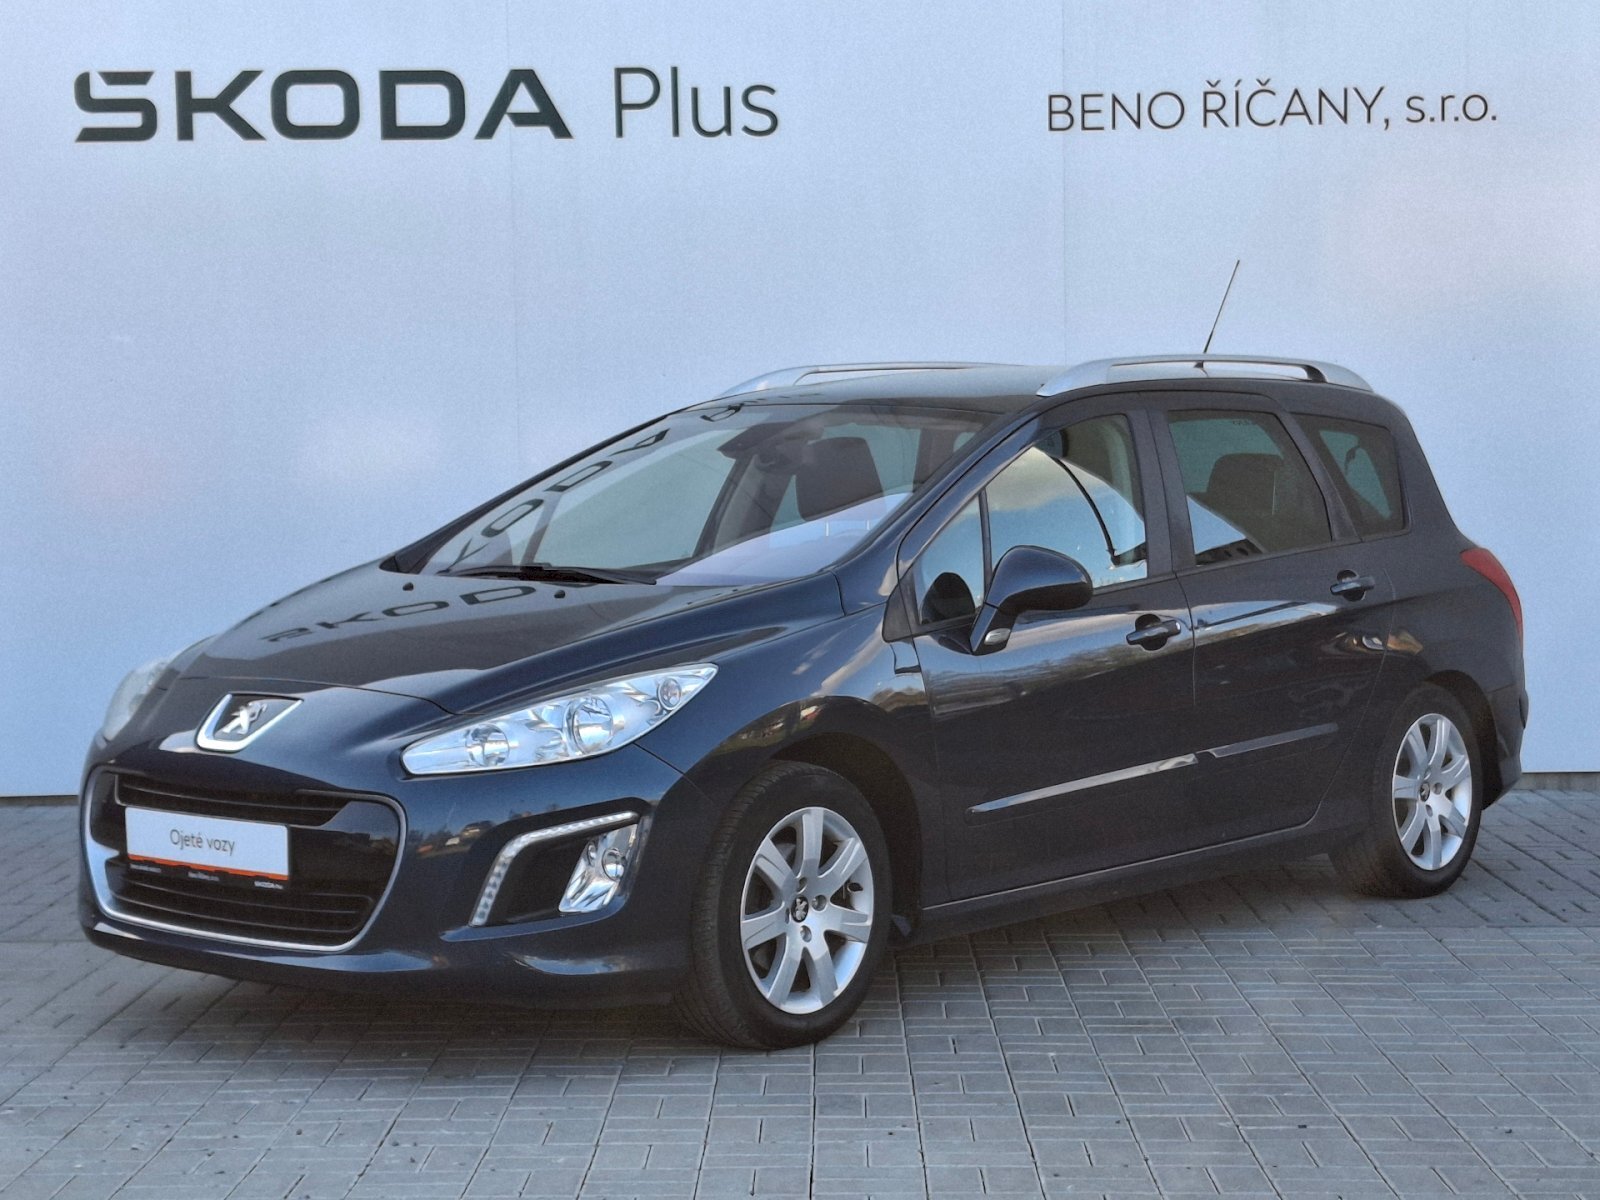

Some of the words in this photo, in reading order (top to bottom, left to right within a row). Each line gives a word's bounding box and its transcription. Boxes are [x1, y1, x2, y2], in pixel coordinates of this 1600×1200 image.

[615, 66, 778, 138] Plus
[1048, 92, 1185, 131] BENO
[1203, 78, 1390, 129] ŘÍČANY,
[1406, 94, 1497, 124] s.r.o.
[169, 829, 203, 850] Ojeté
[207, 838, 236, 855] vozy
